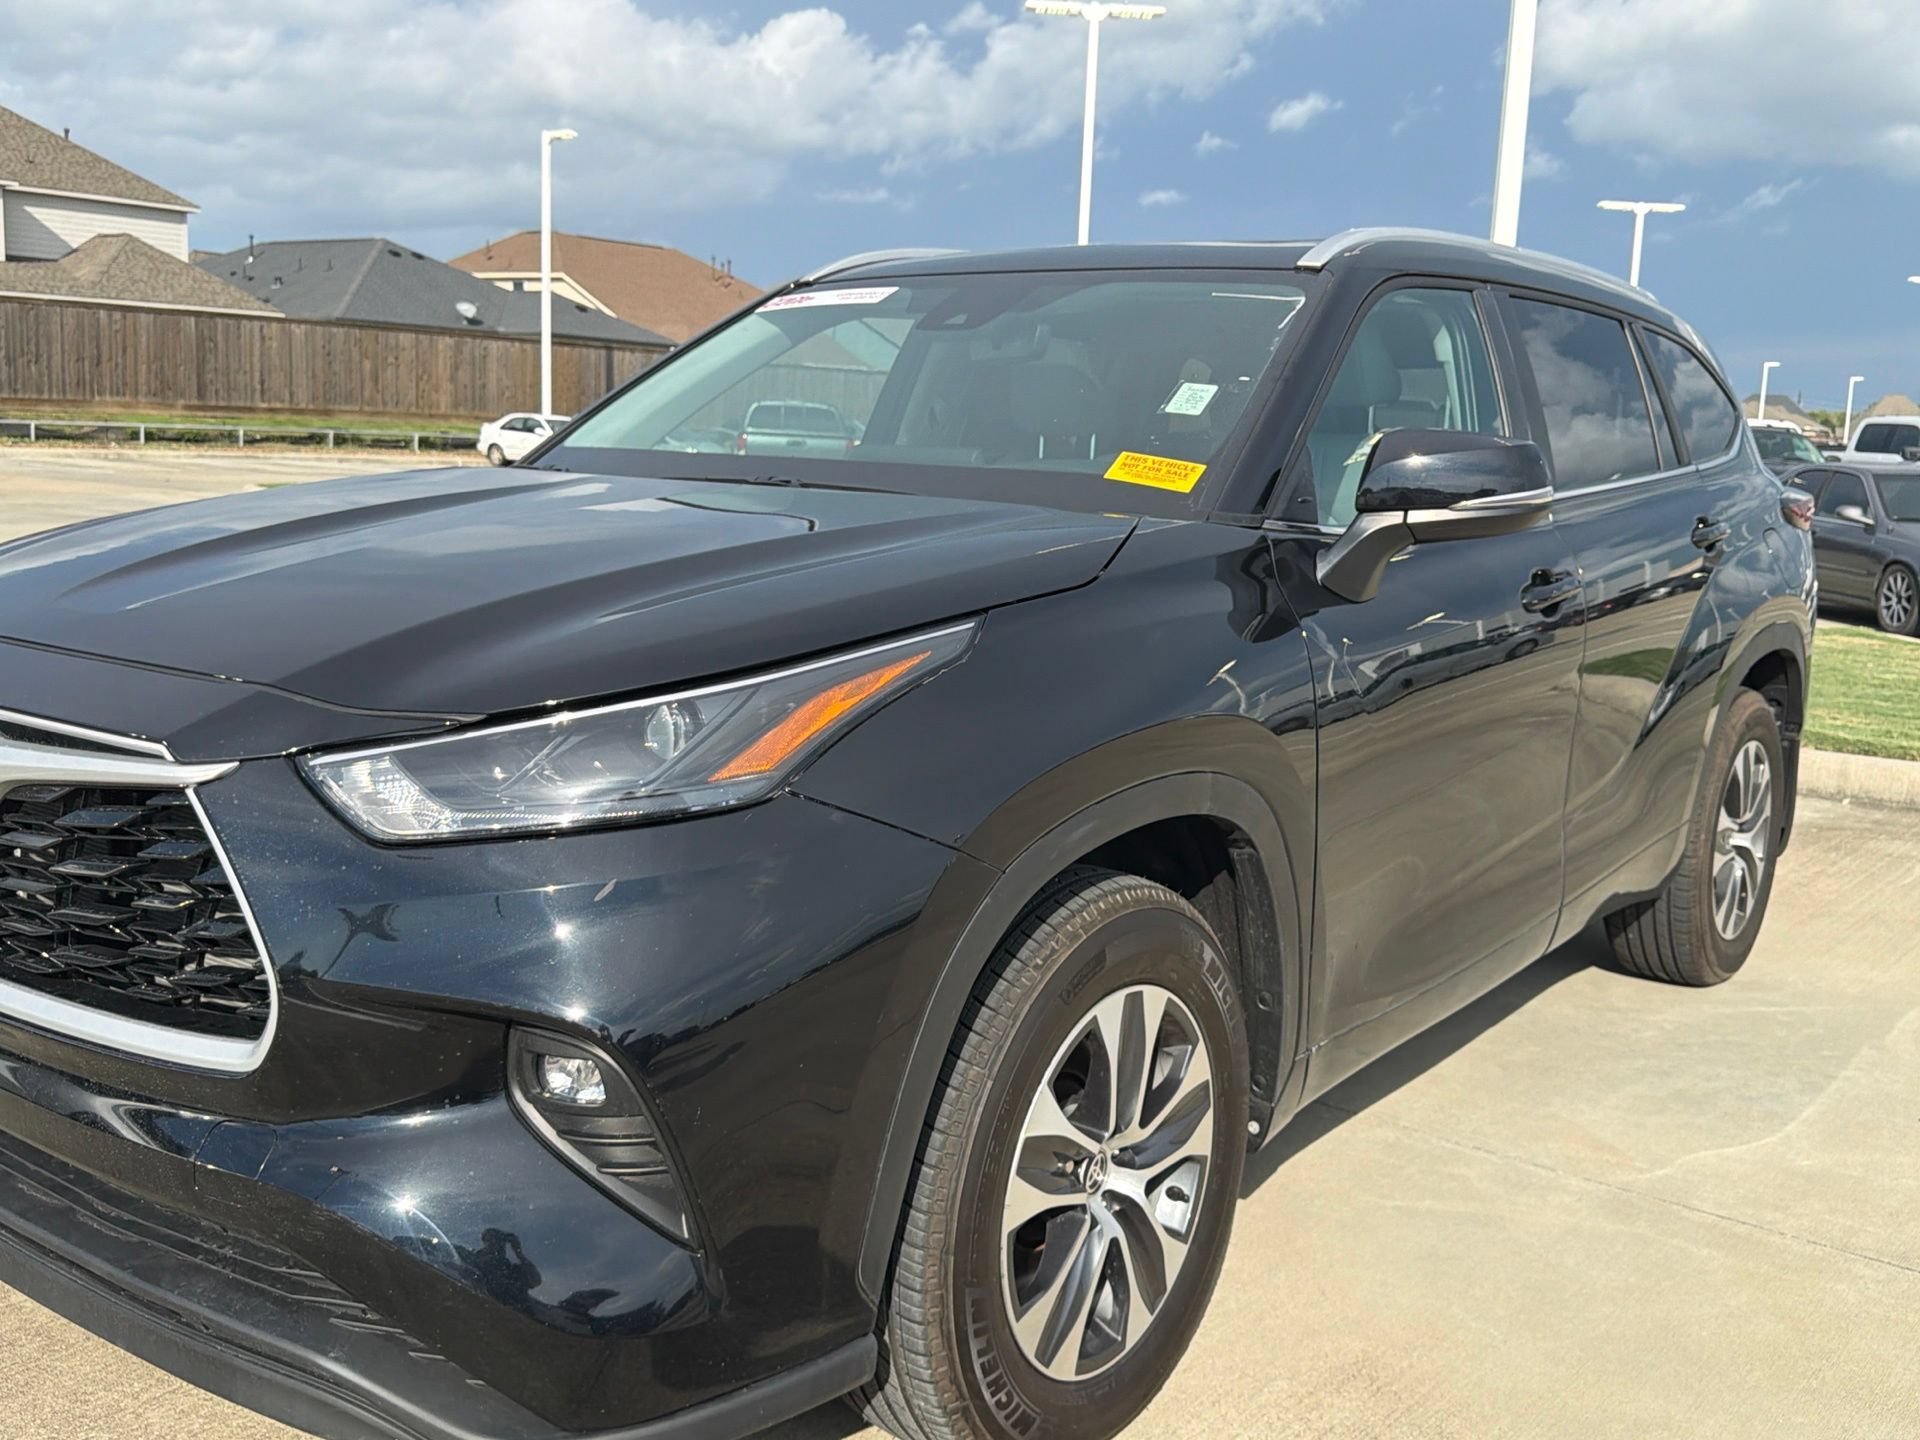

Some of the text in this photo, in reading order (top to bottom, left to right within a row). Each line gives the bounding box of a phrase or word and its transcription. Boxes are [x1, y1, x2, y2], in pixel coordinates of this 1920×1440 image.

[1120, 462, 1139, 470] NOT
[1142, 465, 1162, 473] FOR
[1165, 469, 1191, 479] SALE
[1124, 455, 1198, 473] THIS VEHICLE
[969, 1296, 1039, 1438] MICHELIN
